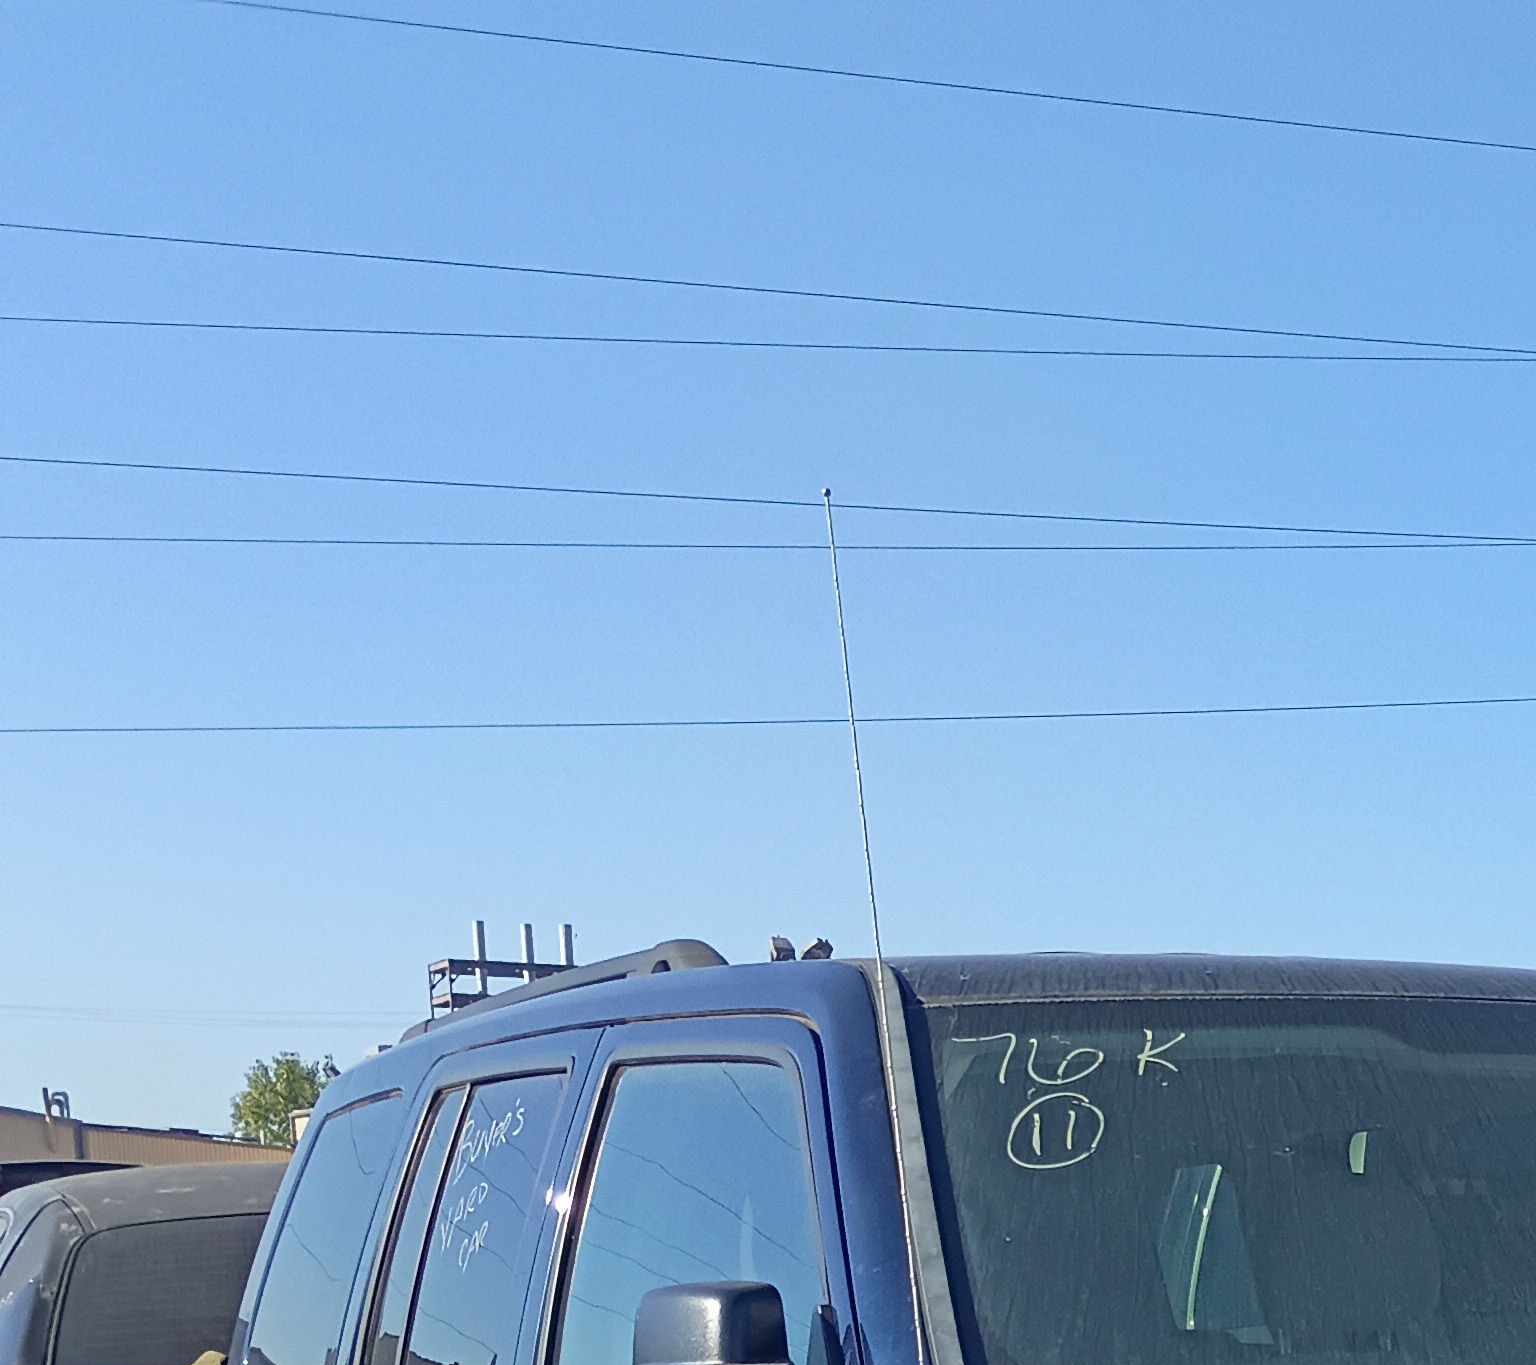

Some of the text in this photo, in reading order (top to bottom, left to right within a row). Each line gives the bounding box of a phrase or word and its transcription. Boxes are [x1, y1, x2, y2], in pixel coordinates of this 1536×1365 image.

[951, 1028, 1186, 1085] 76 K
[1031, 1110, 1076, 1156] 11
